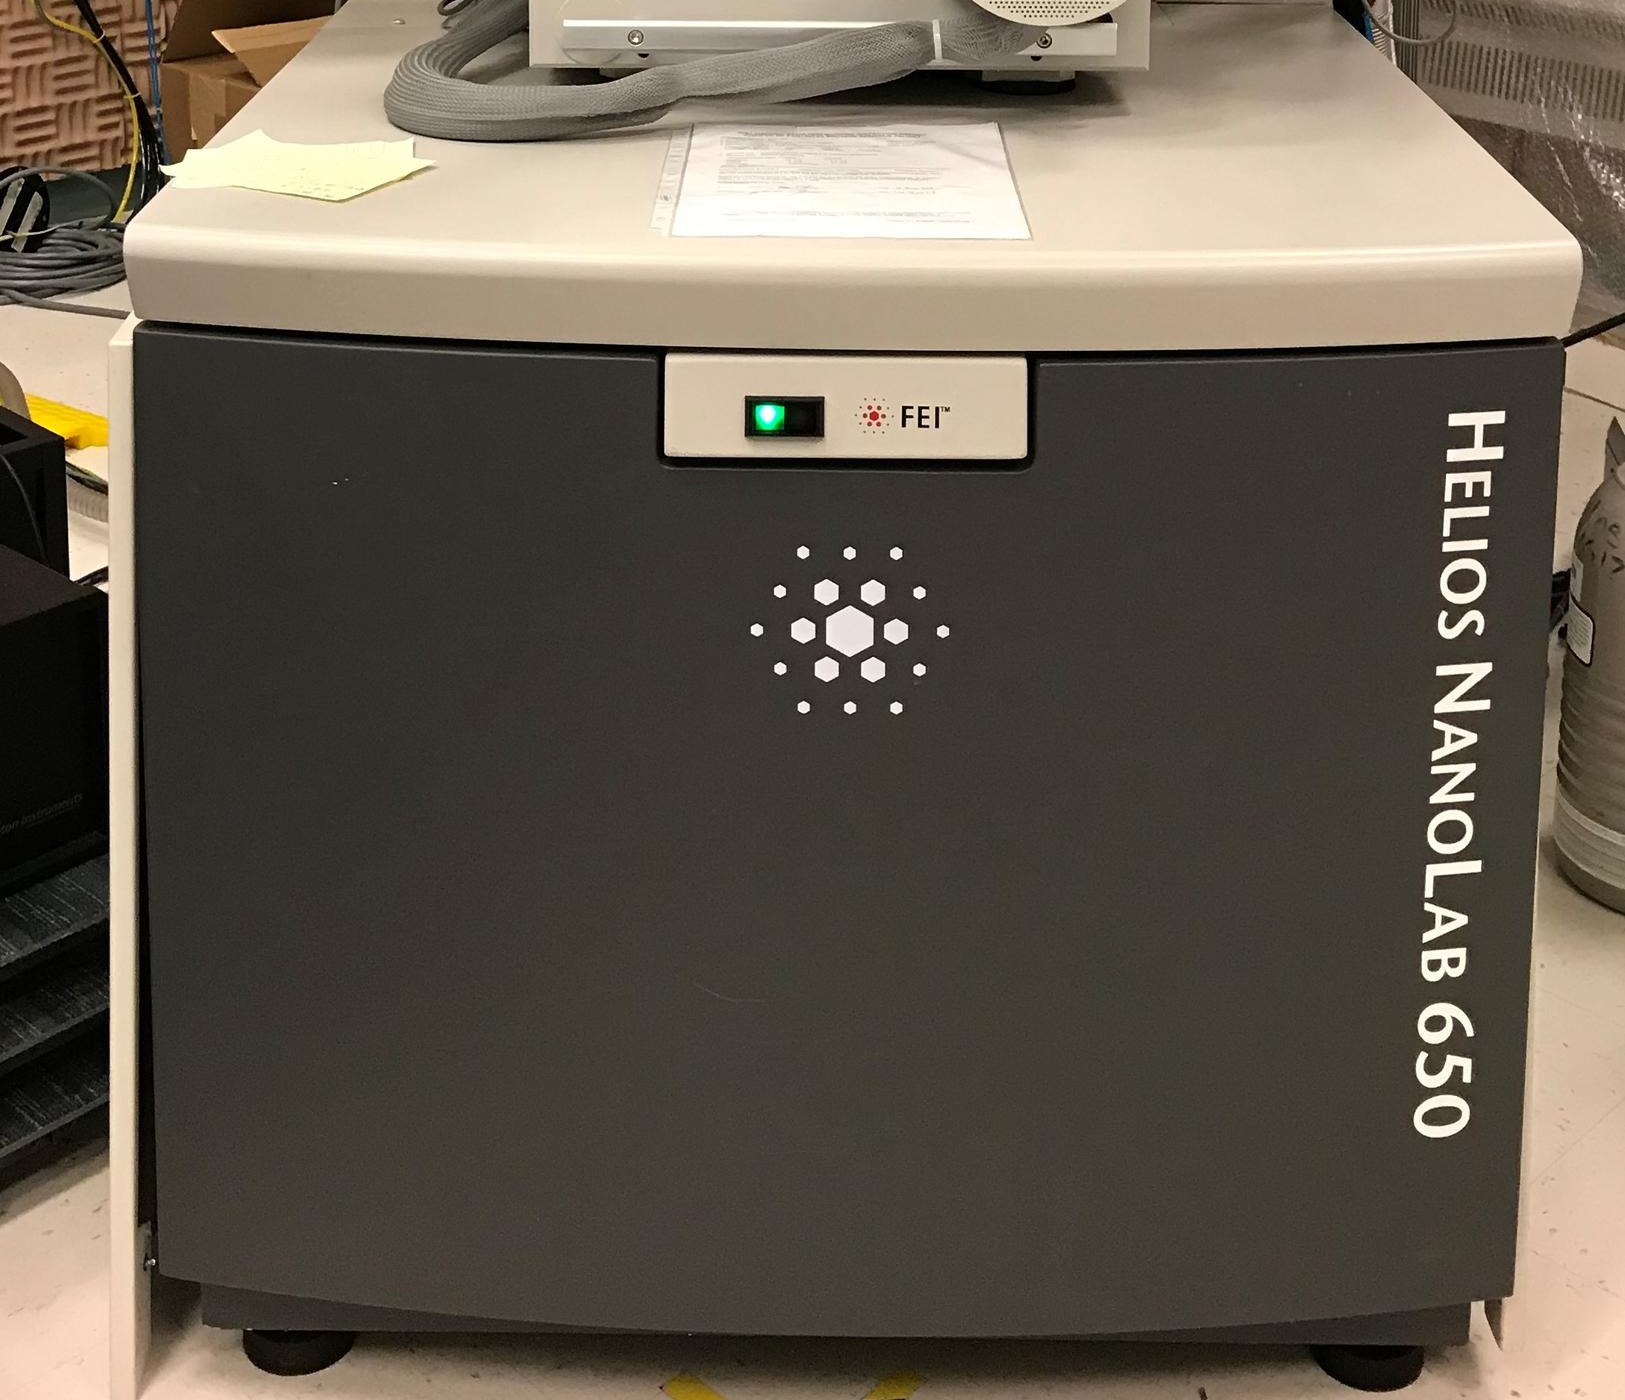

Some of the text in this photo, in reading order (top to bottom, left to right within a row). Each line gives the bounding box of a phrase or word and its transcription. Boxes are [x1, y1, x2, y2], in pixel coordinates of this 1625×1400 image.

[1413, 408, 1506, 1138] HELIOS NANOLAB 650
